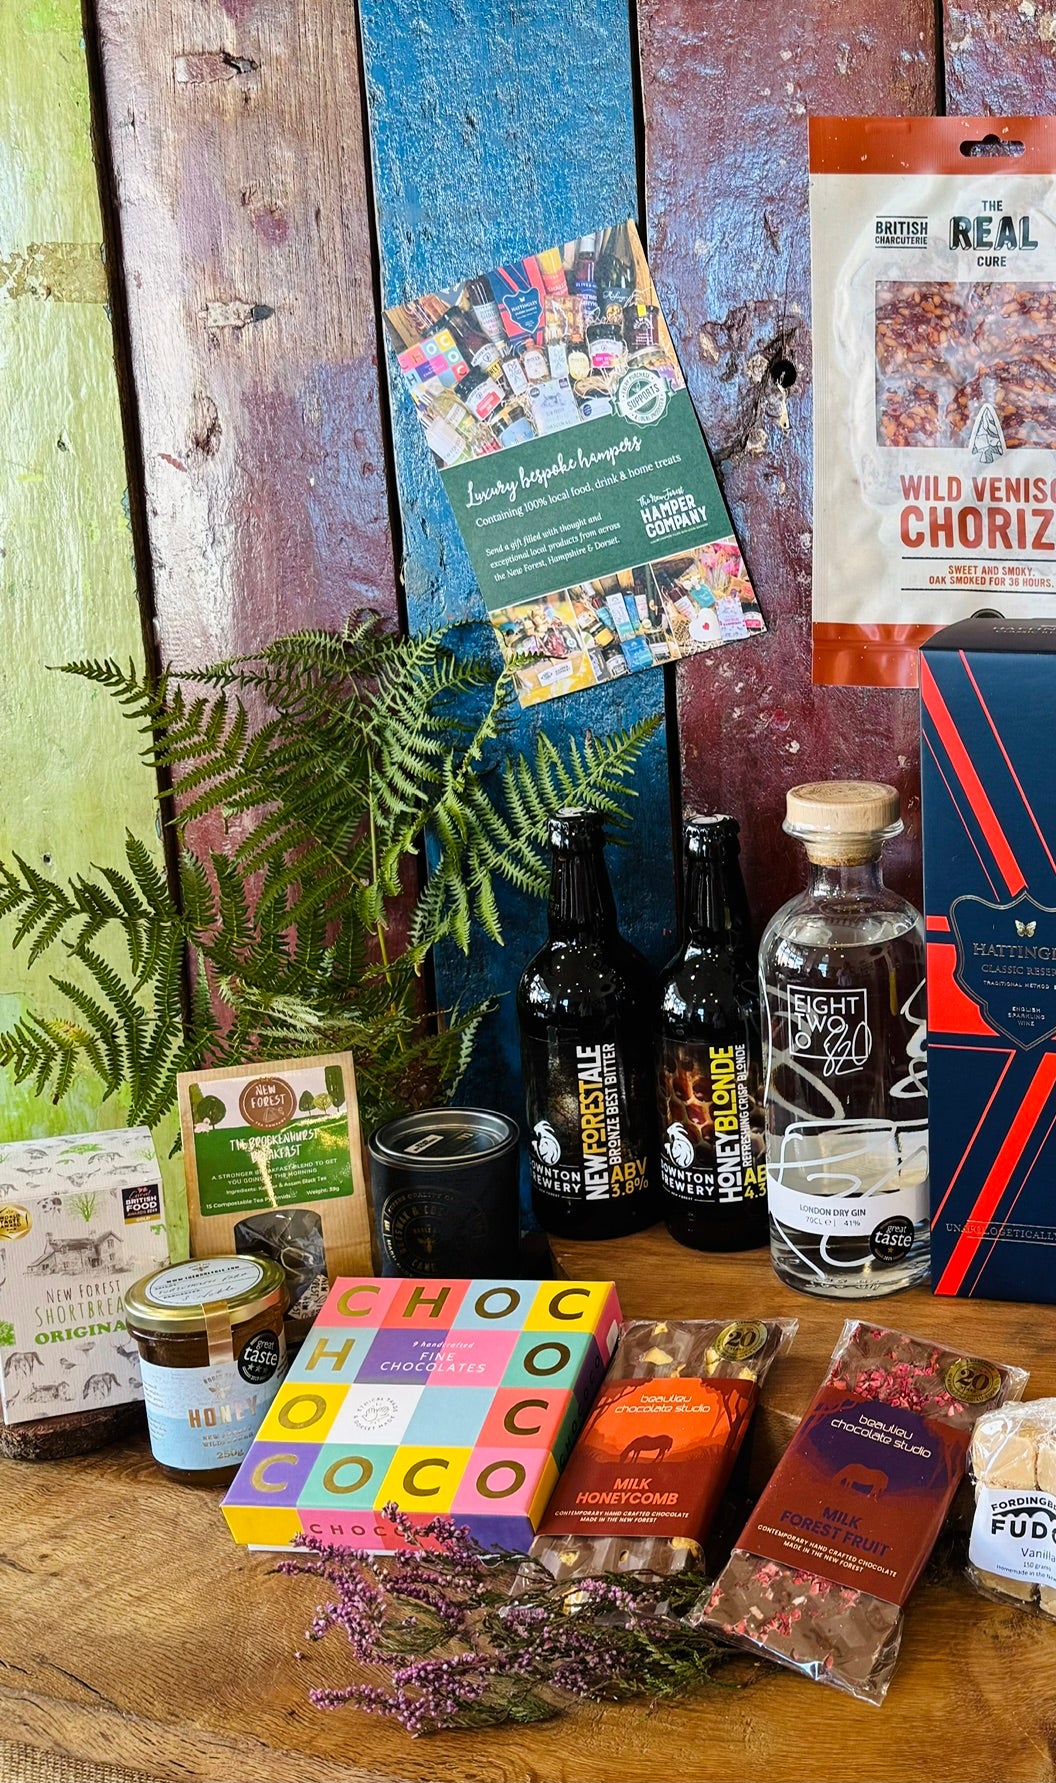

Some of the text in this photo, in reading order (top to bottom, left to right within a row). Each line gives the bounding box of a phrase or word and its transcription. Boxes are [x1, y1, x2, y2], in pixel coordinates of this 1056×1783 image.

[982, 200, 1003, 211] THE
[875, 236, 927, 245] CHARCUTERIE
[949, 216, 1039, 251] REAL
[977, 256, 1007, 267] CURE
[466, 436, 642, 508] Luxury bespoke hampers
[476, 454, 682, 528] Containing 100% local food, drink home treats
[900, 475, 962, 502] WILD
[640, 493, 696, 522] HAMPER
[646, 505, 708, 538] COMPANY
[948, 565, 999, 575] SWEET AND
[929, 576, 1006, 586] OAK SMOKED FOR
[981, 964, 1023, 975] CLASSIC
[794, 995, 859, 1015] EIGHT
[794, 1013, 846, 1034] TWO
[255, 1084, 276, 1096] NEW
[602, 1043, 622, 1166] BRONZE BEST BITTER
[611, 1156, 648, 1184] ABV
[125, 1201, 157, 1213] FOOD
[800, 1204, 866, 1217] LONDON DRY GIN
[79, 1279, 121, 1299] FOREST
[34, 1319, 126, 1345] ORIGINA
[244, 1346, 278, 1367] taste
[419, 1352, 455, 1361] FINE
[380, 1360, 487, 1374] CHOCOLATES
[955, 1368, 990, 1390] 20
[615, 1403, 711, 1414] chocolate studio
[613, 1478, 652, 1490] MILK
[576, 1492, 678, 1505] HONEYCOMB
[822, 1506, 863, 1530] MILK
[757, 1524, 809, 1546] CONTEMPORARY
[780, 1510, 890, 1558] FOREST FRUIT
[1021, 1548, 1056, 1563] Vanilla
